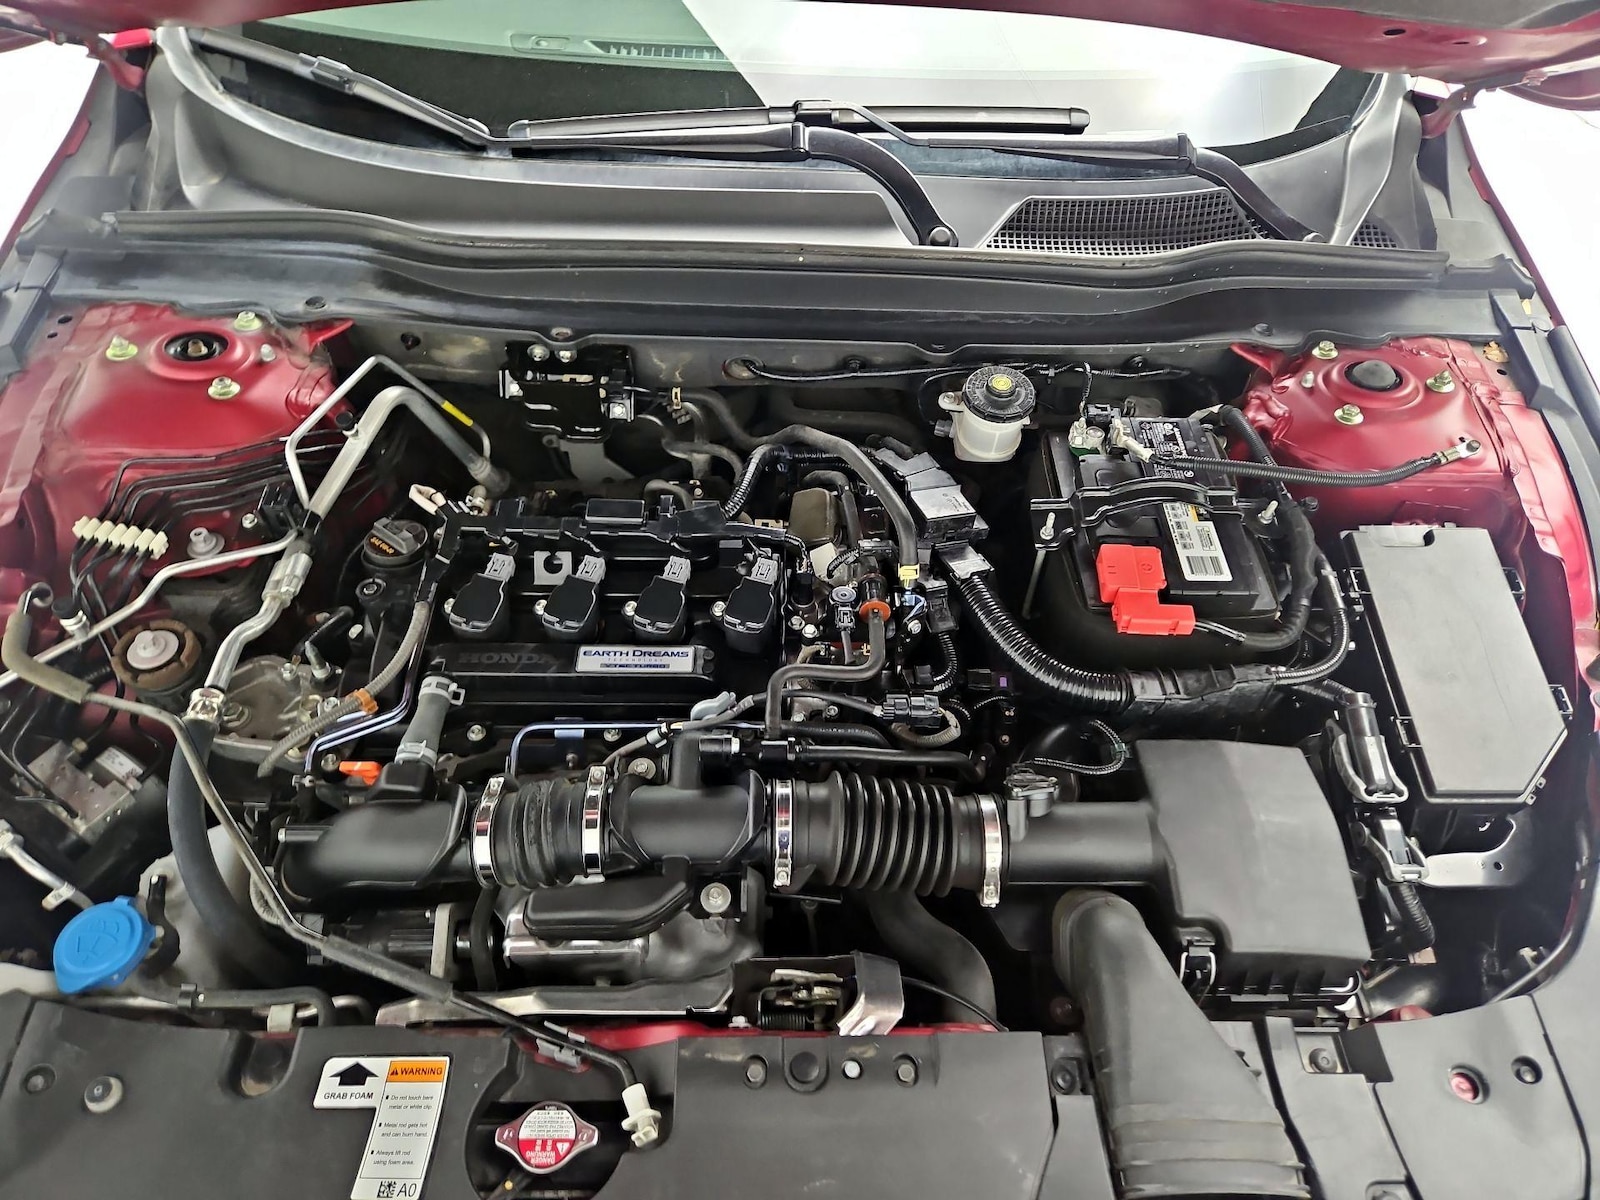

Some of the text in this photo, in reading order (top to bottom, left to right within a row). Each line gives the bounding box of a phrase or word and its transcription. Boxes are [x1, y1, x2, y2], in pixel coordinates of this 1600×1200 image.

[632, 649, 689, 657] DREAMS
[459, 652, 560, 665] HONDA
[400, 1067, 443, 1076] WARNING
[323, 1092, 374, 1100] GRAB FOAM
[530, 1157, 556, 1165] DANGER
[397, 1182, 417, 1198] A0
